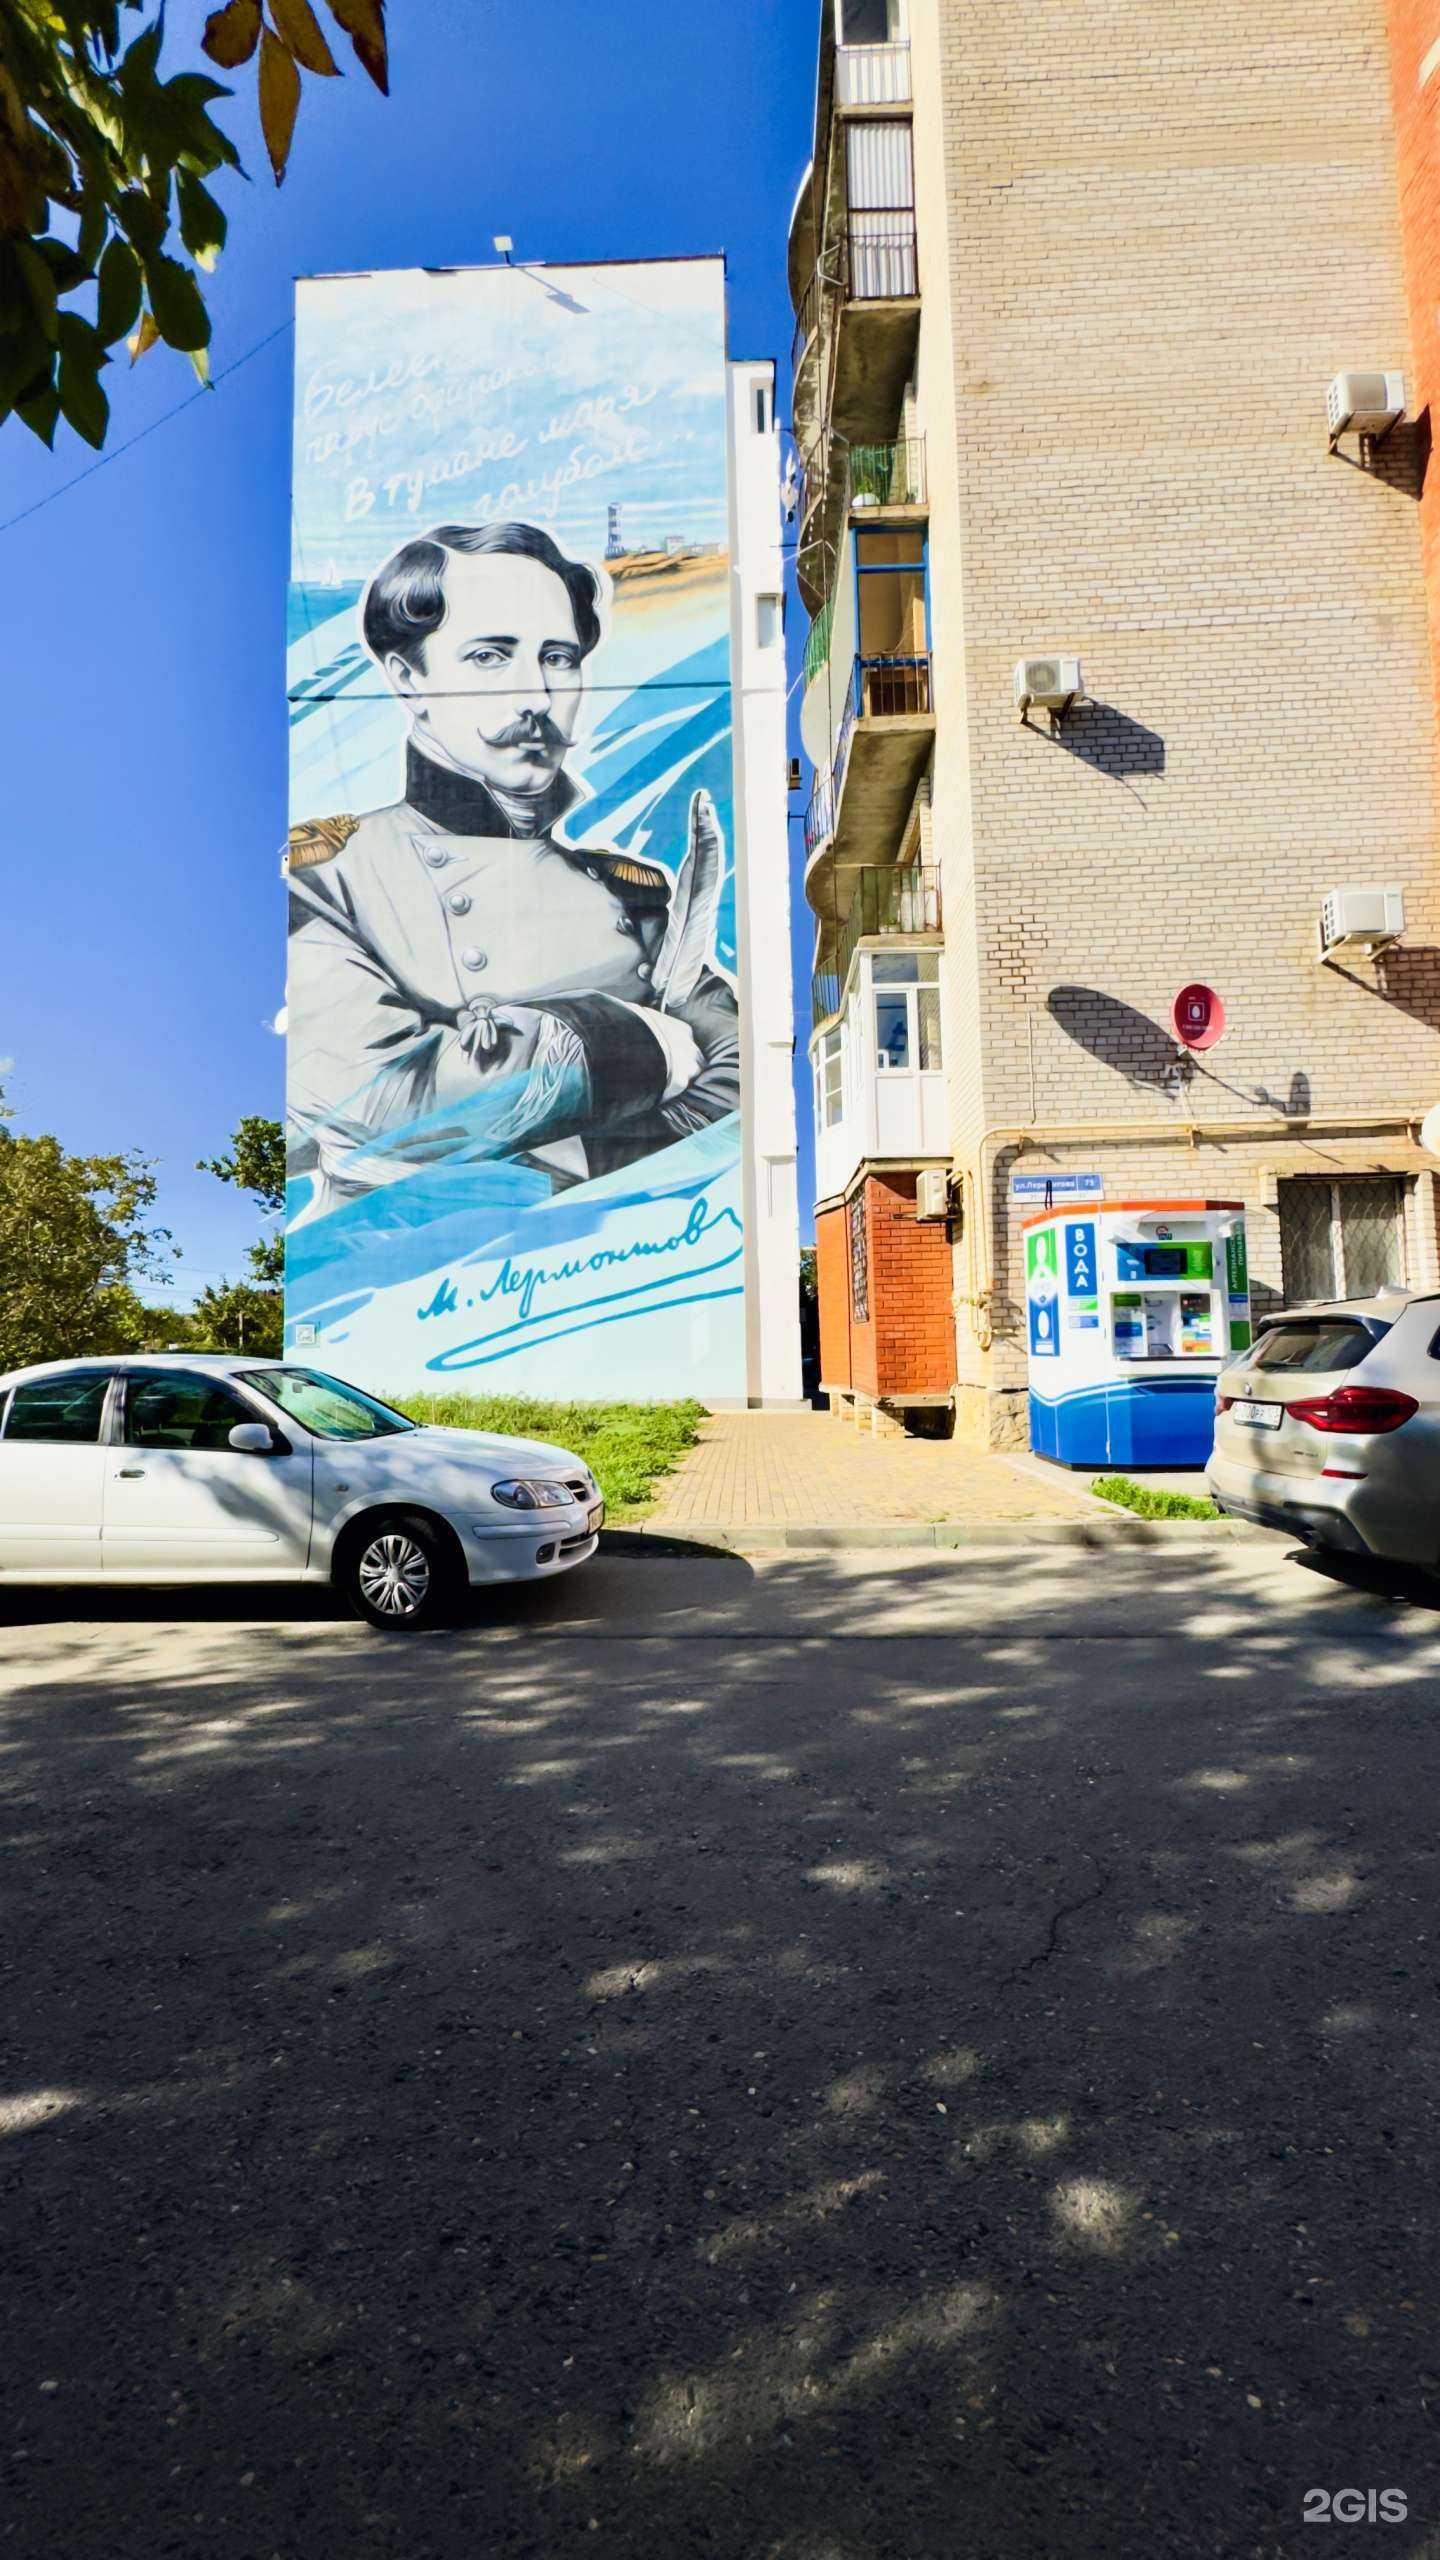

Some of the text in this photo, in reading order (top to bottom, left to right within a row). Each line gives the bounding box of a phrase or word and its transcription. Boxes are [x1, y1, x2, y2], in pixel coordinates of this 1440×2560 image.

[344, 477, 376, 522] В
[480, 1197, 724, 1319] Лермонтов
[1073, 1228, 1090, 1288] ВОДА
